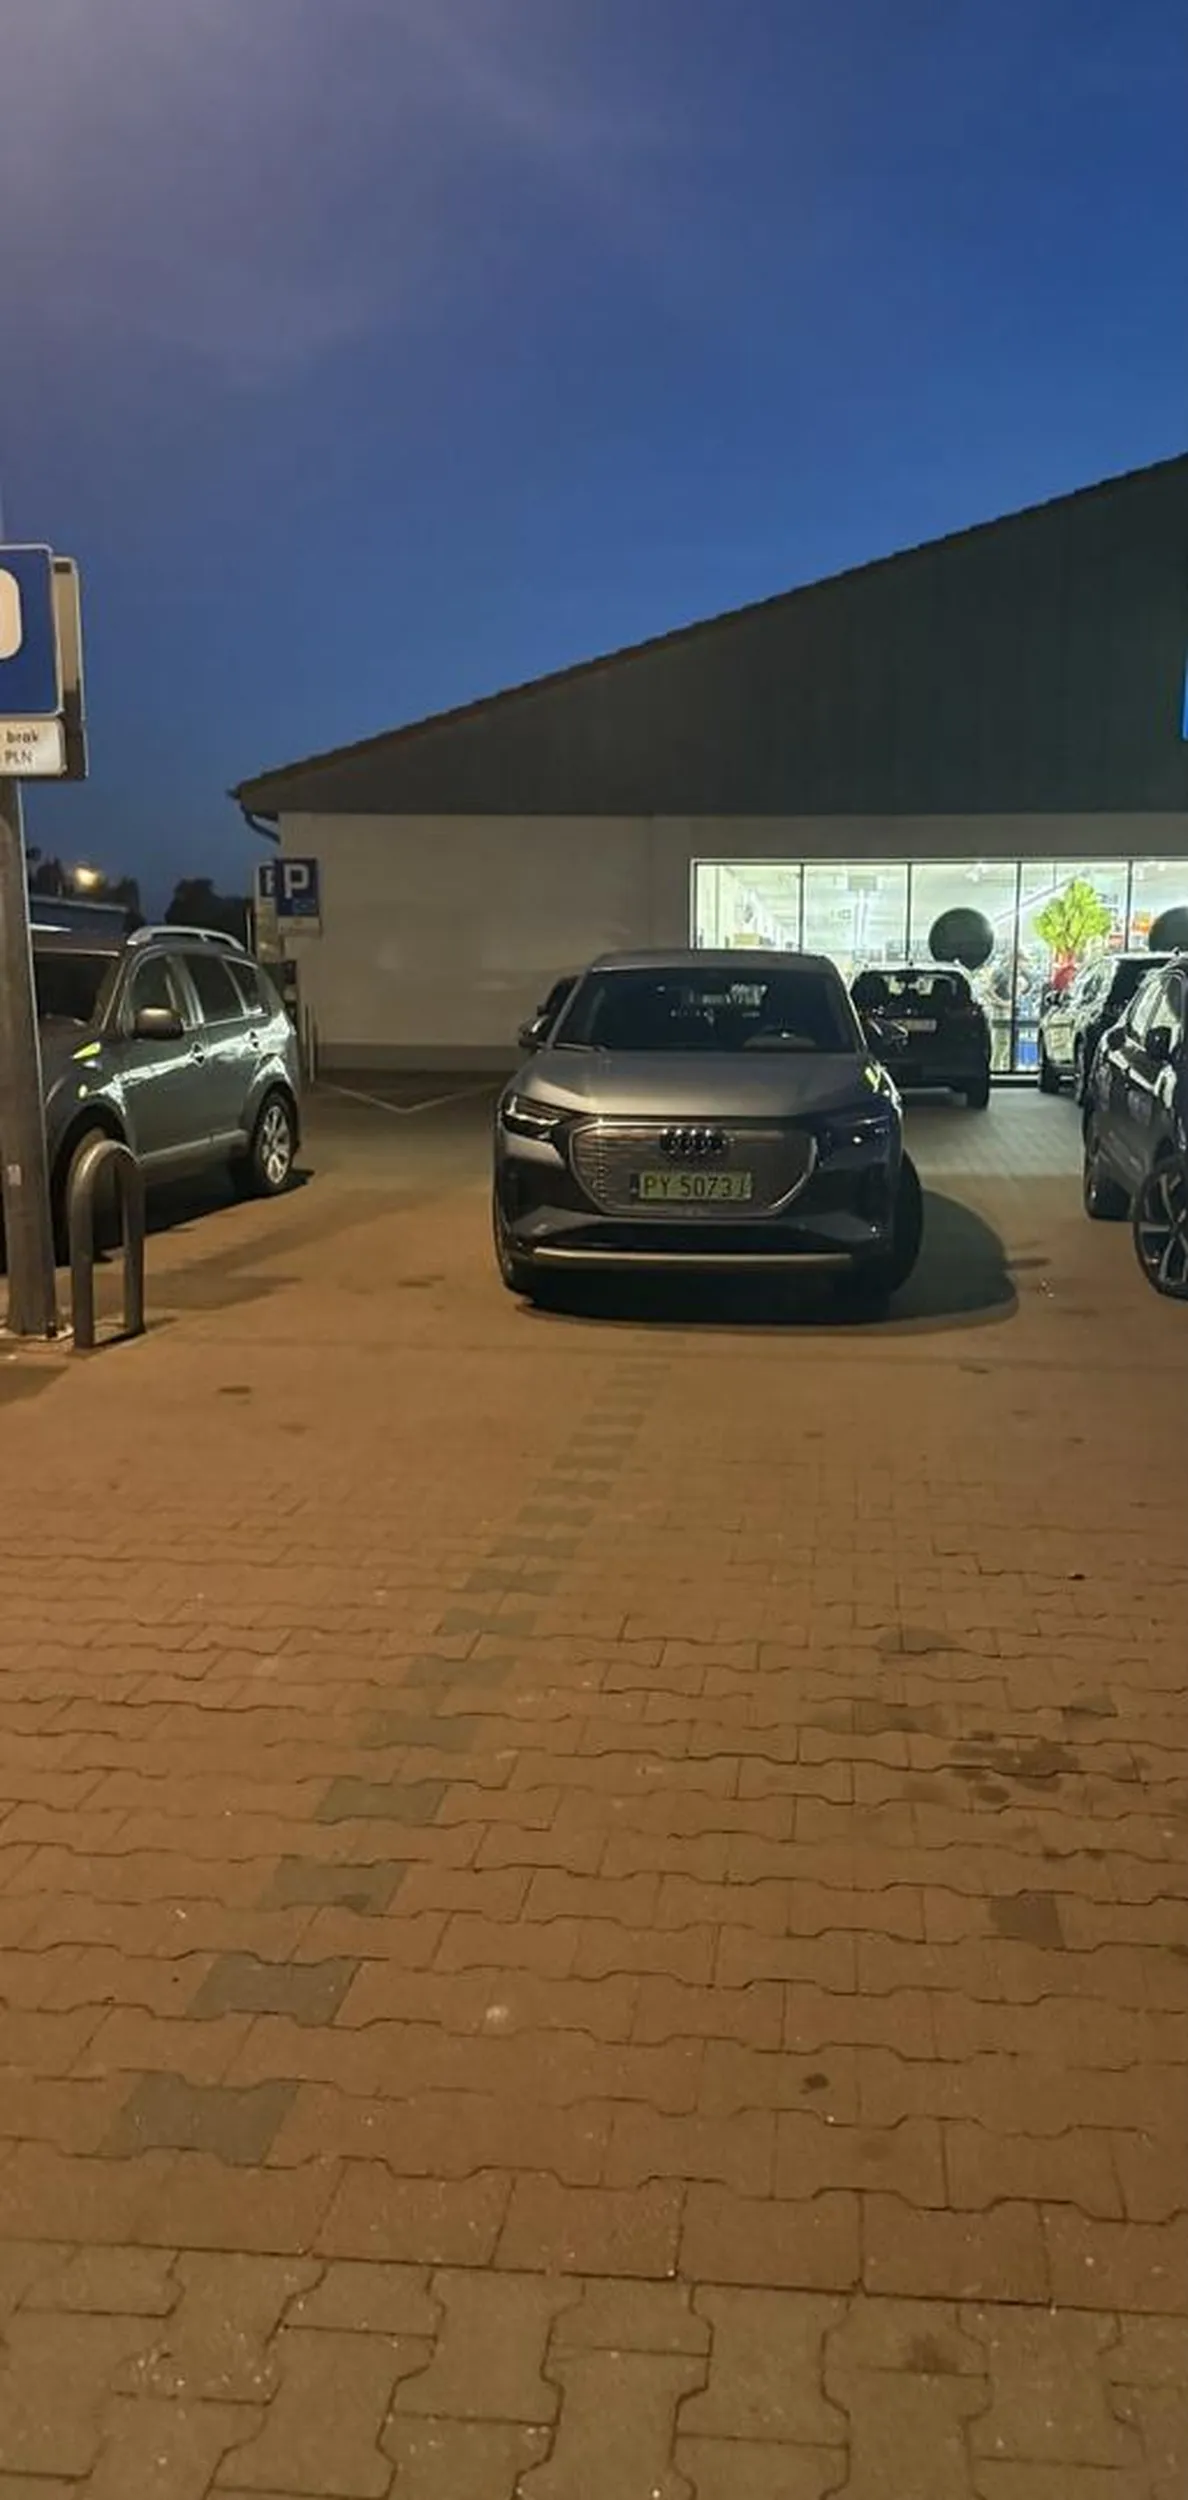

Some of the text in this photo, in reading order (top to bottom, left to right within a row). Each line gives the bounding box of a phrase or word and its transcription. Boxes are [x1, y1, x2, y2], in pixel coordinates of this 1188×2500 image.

[6, 729, 38, 743] brak
[5, 750, 32, 764] PLN
[283, 864, 309, 899] P
[643, 1174, 671, 1197] PY
